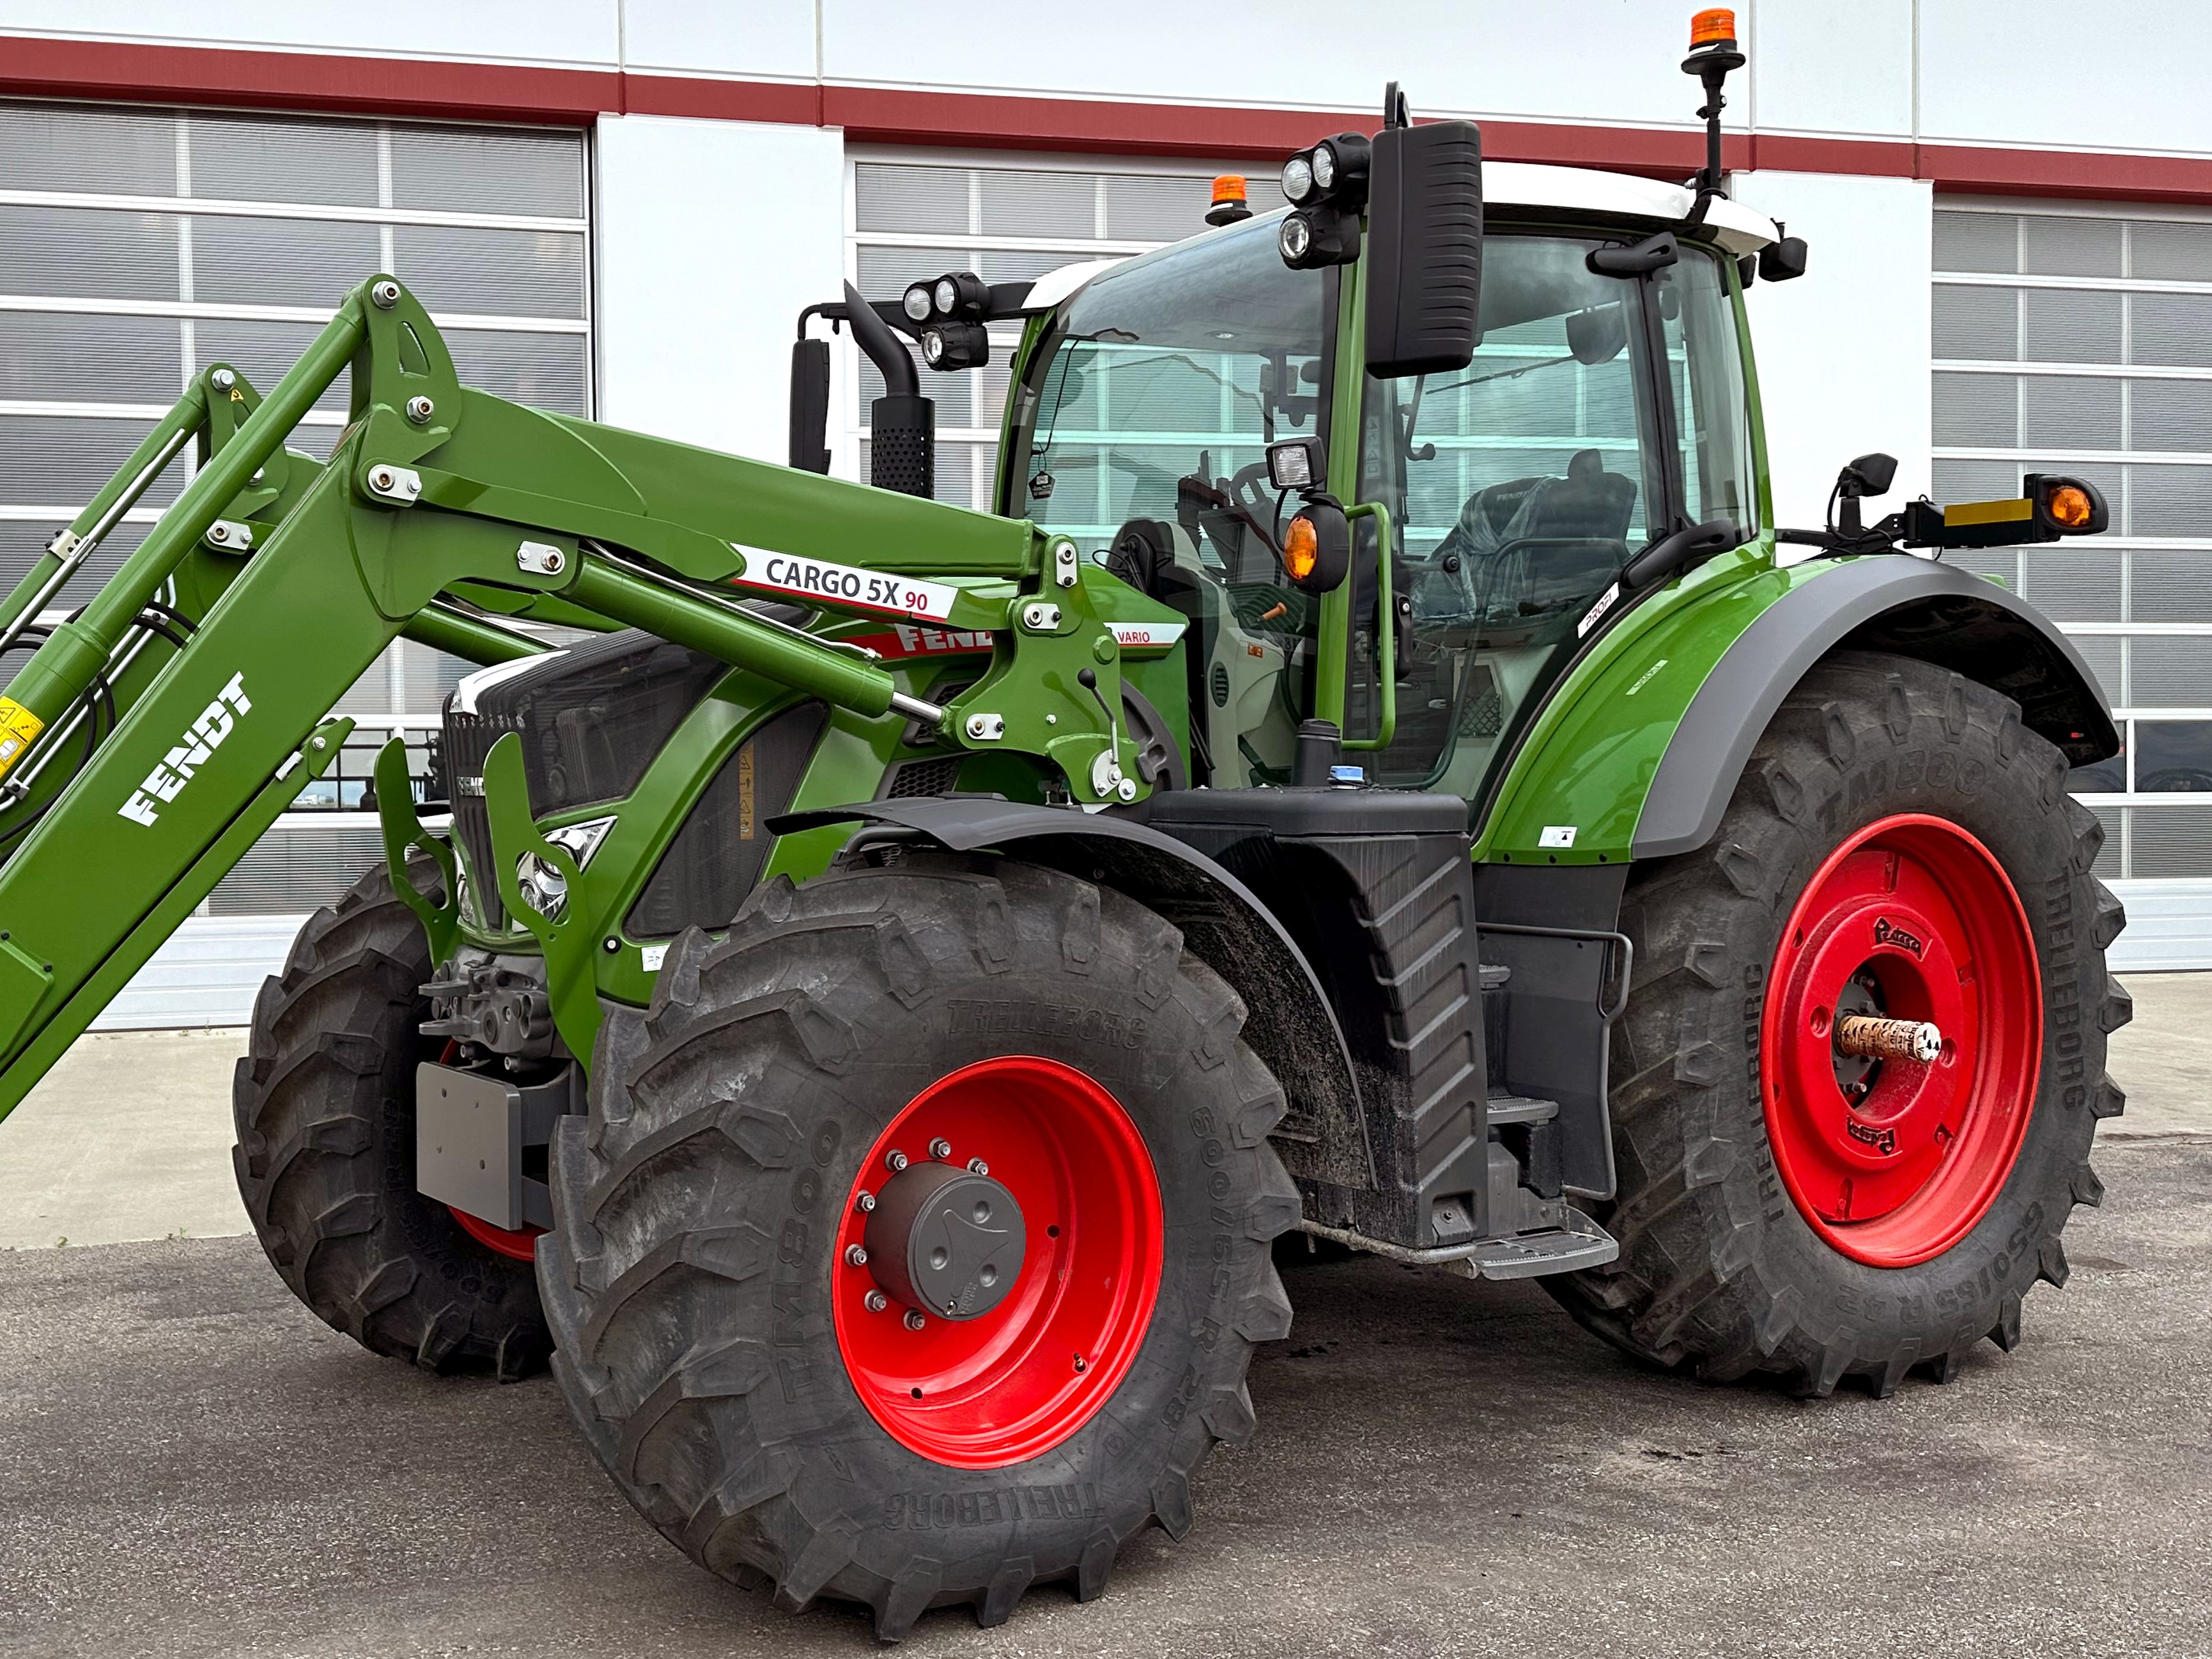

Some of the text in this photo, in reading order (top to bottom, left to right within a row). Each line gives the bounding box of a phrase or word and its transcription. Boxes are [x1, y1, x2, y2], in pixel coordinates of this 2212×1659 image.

[766, 559, 927, 610] CARGO 5X 90
[1586, 592, 1612, 628] PROFI
[1117, 631, 1150, 643] VARIO
[117, 670, 252, 827] FENDT
[2045, 865, 2086, 1111] TRELLEBORG
[947, 999, 1147, 1049] TRELLEBORG
[883, 1482, 1107, 1531] TRELLEBORG
